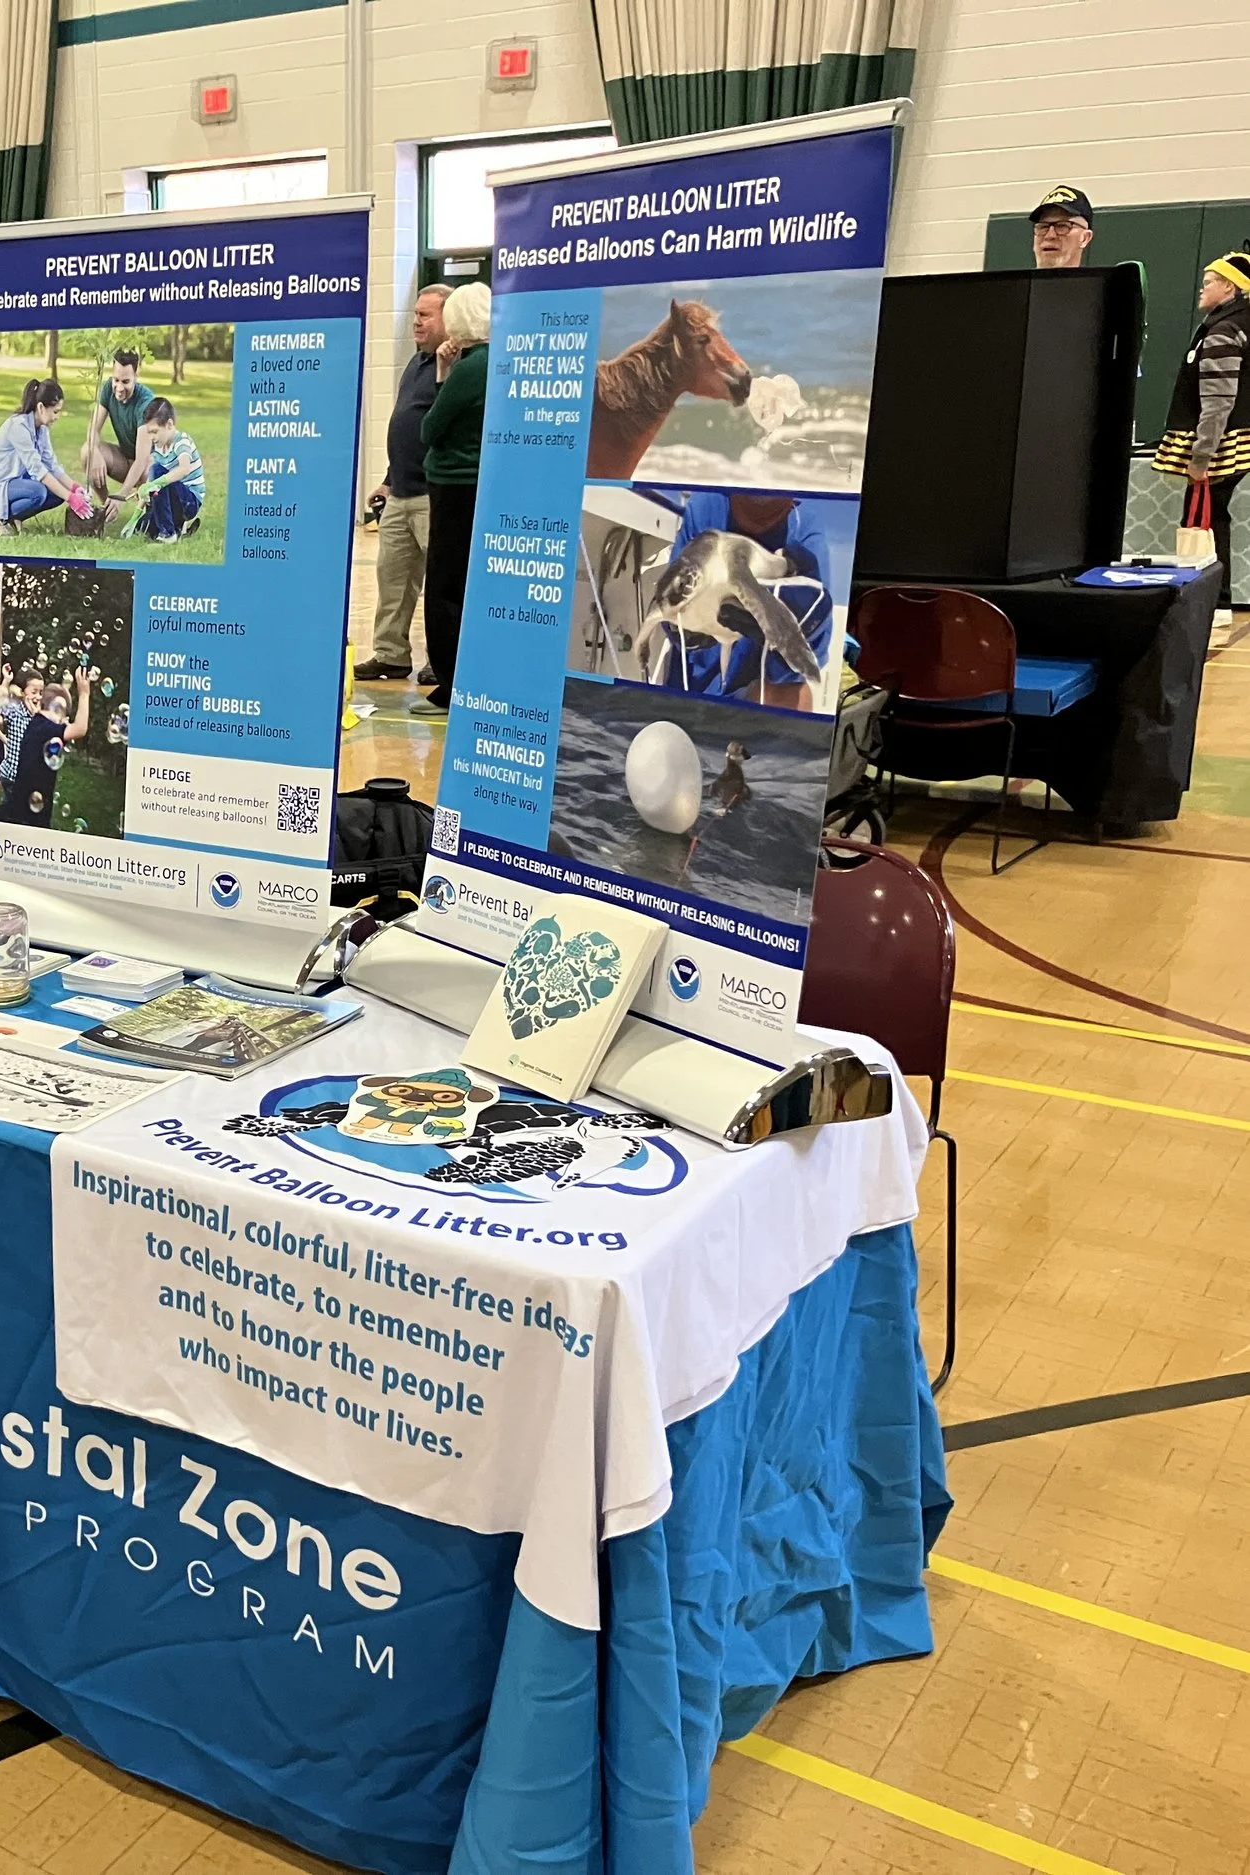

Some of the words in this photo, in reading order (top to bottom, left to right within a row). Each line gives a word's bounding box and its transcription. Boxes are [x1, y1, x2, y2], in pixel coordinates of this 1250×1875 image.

[551, 197, 624, 228] PREVENT
[627, 186, 711, 219] BALLOON
[715, 176, 781, 210] LITTER
[498, 240, 571, 271] Released
[575, 233, 655, 262] Balloons
[660, 228, 699, 254] Can
[706, 222, 762, 252] Harm
[767, 210, 857, 245] Wildlife
[45, 254, 121, 277] PREVENT
[125, 249, 207, 274] BALLOON
[212, 244, 274, 268] LITTER
[41, 287, 66, 307] and
[70, 283, 143, 306] Remember
[149, 279, 204, 302] without
[208, 277, 284, 302] Releasing
[288, 272, 360, 295] Balloons
[541, 312, 560, 328] This
[563, 311, 589, 327] horse
[251, 333, 325, 351] REMEMBER
[549, 332, 587, 350] KNOW
[250, 359, 257, 372] a
[261, 357, 292, 373] loved
[296, 358, 321, 372] one
[512, 358, 553, 375] THERE
[557, 355, 585, 374] WAS
[250, 379, 275, 395] with
[278, 382, 285, 394] a
[508, 382, 518, 399] A
[520, 380, 582, 399] BALLOON
[249, 400, 300, 417] LASTING
[524, 408, 533, 421] in
[536, 408, 553, 422] the
[555, 411, 580, 427] grass
[248, 421, 321, 439] MEMORIAL.
[503, 431, 518, 445] she
[522, 433, 542, 446] was
[545, 431, 577, 448] eating.
[246, 458, 284, 475] PLANT
[287, 458, 297, 474] A
[246, 479, 274, 496] TREE
[244, 503, 282, 518] instead
[285, 503, 297, 517] of
[243, 524, 290, 543] releasing
[499, 514, 518, 530] This
[521, 515, 539, 531] Sea
[542, 517, 569, 534] Turtle
[242, 545, 289, 561] balloons.
[484, 533, 541, 555] THOUGHT
[544, 538, 566, 557] SHE
[487, 556, 564, 580] SWALLOWED
[528, 583, 562, 603] FOOD
[149, 596, 218, 614] CELEBRATE
[488, 605, 505, 619] not
[508, 610, 514, 621] a
[518, 606, 559, 627] balloon.
[148, 616, 182, 634] joyful
[185, 620, 246, 637] moments
[147, 652, 186, 670] ENJOY
[189, 655, 210, 671] the
[146, 672, 212, 692] UPLIFTING
[146, 693, 183, 712] power
[187, 695, 199, 710] of
[203, 696, 261, 716] BUBBLES
[466, 692, 508, 715] balloon
[511, 703, 549, 723] traveled
[144, 714, 179, 729] instead
[183, 715, 194, 730] of
[197, 717, 244, 737] releasing
[474, 721, 499, 741] many
[502, 722, 527, 742] miles
[529, 728, 547, 746] and
[476, 738, 545, 768] ENTANGLED
[142, 767, 146, 777] I
[149, 767, 191, 783] PLEDGE
[453, 758, 469, 773] this
[471, 761, 522, 787] INNOCENT
[524, 772, 542, 791] bird
[142, 785, 151, 796] to
[153, 786, 195, 802] celebrate
[198, 789, 215, 803] and
[218, 792, 269, 809] remember
[474, 785, 501, 806] along
[503, 789, 519, 806] the
[520, 796, 540, 816] way.
[141, 801, 176, 815] without
[179, 804, 220, 824] releasing
[223, 808, 267, 826] balloons!
[4, 840, 55, 862] Prevent
[61, 848, 112, 870] Balloon
[117, 857, 186, 885] Litter.org
[258, 880, 318, 903] MARCO
[459, 884, 508, 914] Prevent
[463, 841, 467, 852] I
[468, 843, 499, 863] PLEDGE
[501, 851, 513, 865] TO
[514, 854, 563, 880] CELEBRATE
[563, 867, 582, 885] AND
[583, 873, 635, 902] REMEMBER
[636, 886, 679, 914] WITHOUT
[681, 901, 736, 932] RELEASING
[737, 919, 800, 953] BALLOONS!
[721, 973, 786, 1009] MARCO
[142, 1115, 258, 1174] Prevent
[250, 1167, 400, 1219] Balloon
[407, 1207, 628, 1252] Litter.org
[73, 1160, 237, 1241] Inspirational,
[244, 1216, 357, 1279] colorful,
[365, 1249, 513, 1323] litter-free
[523, 1295, 594, 1359] ideas
[145, 1231, 172, 1260] to
[180, 1241, 306, 1314] celebrate,
[312, 1286, 341, 1318] to
[348, 1304, 506, 1371] remember
[159, 1284, 207, 1318] and
[212, 1300, 234, 1326] to
[241, 1308, 322, 1359] honor
[328, 1342, 375, 1380] the
[382, 1362, 485, 1416] people
[178, 1334, 231, 1374] who
[236, 1354, 328, 1413] impact
[334, 1394, 380, 1429] our
[386, 1410, 464, 1460] lives.
[179, 1455, 402, 1611] Zone
[26, 1500, 395, 1680] PROGRAM
